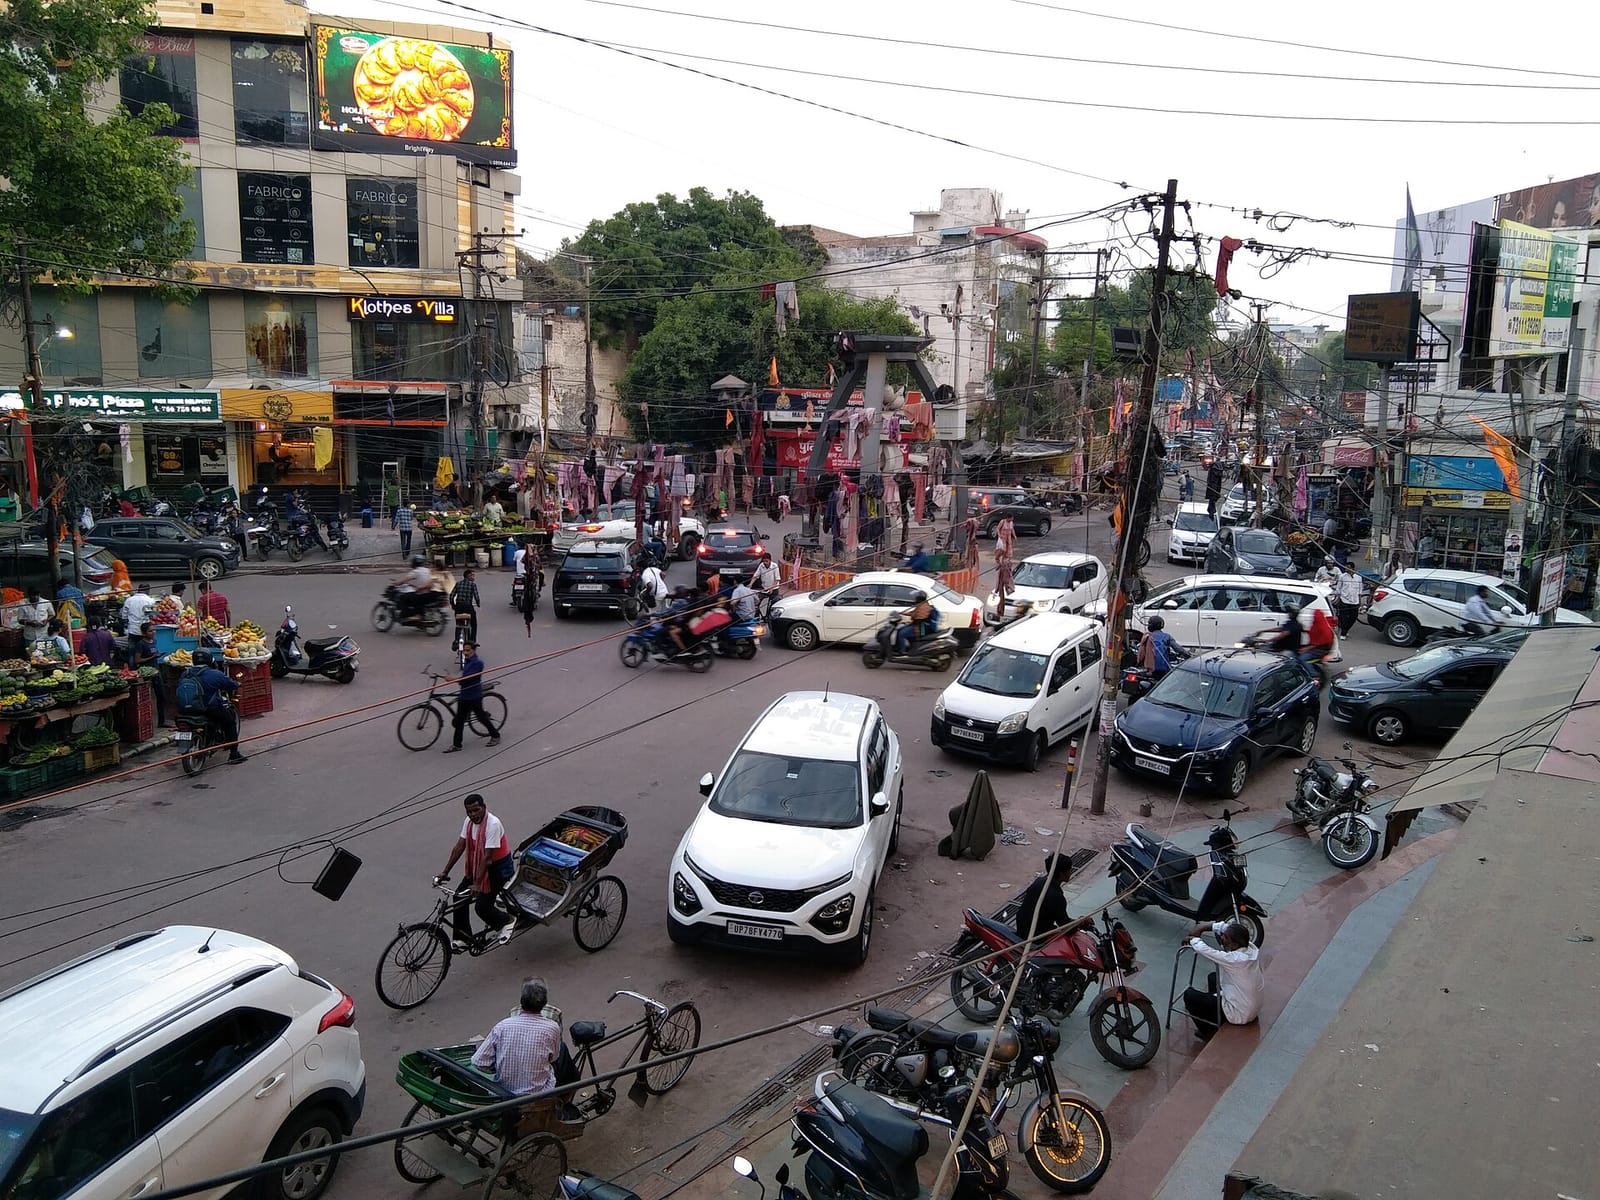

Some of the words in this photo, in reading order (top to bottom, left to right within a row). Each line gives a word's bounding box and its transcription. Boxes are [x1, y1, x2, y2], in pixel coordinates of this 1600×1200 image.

[158, 34, 193, 52] Bud
[247, 185, 302, 199] FABRICO
[355, 190, 408, 204] FABRICO
[351, 297, 413, 319] Klothes
[417, 299, 455, 316] Villa
[102, 395, 145, 409] Pizza
